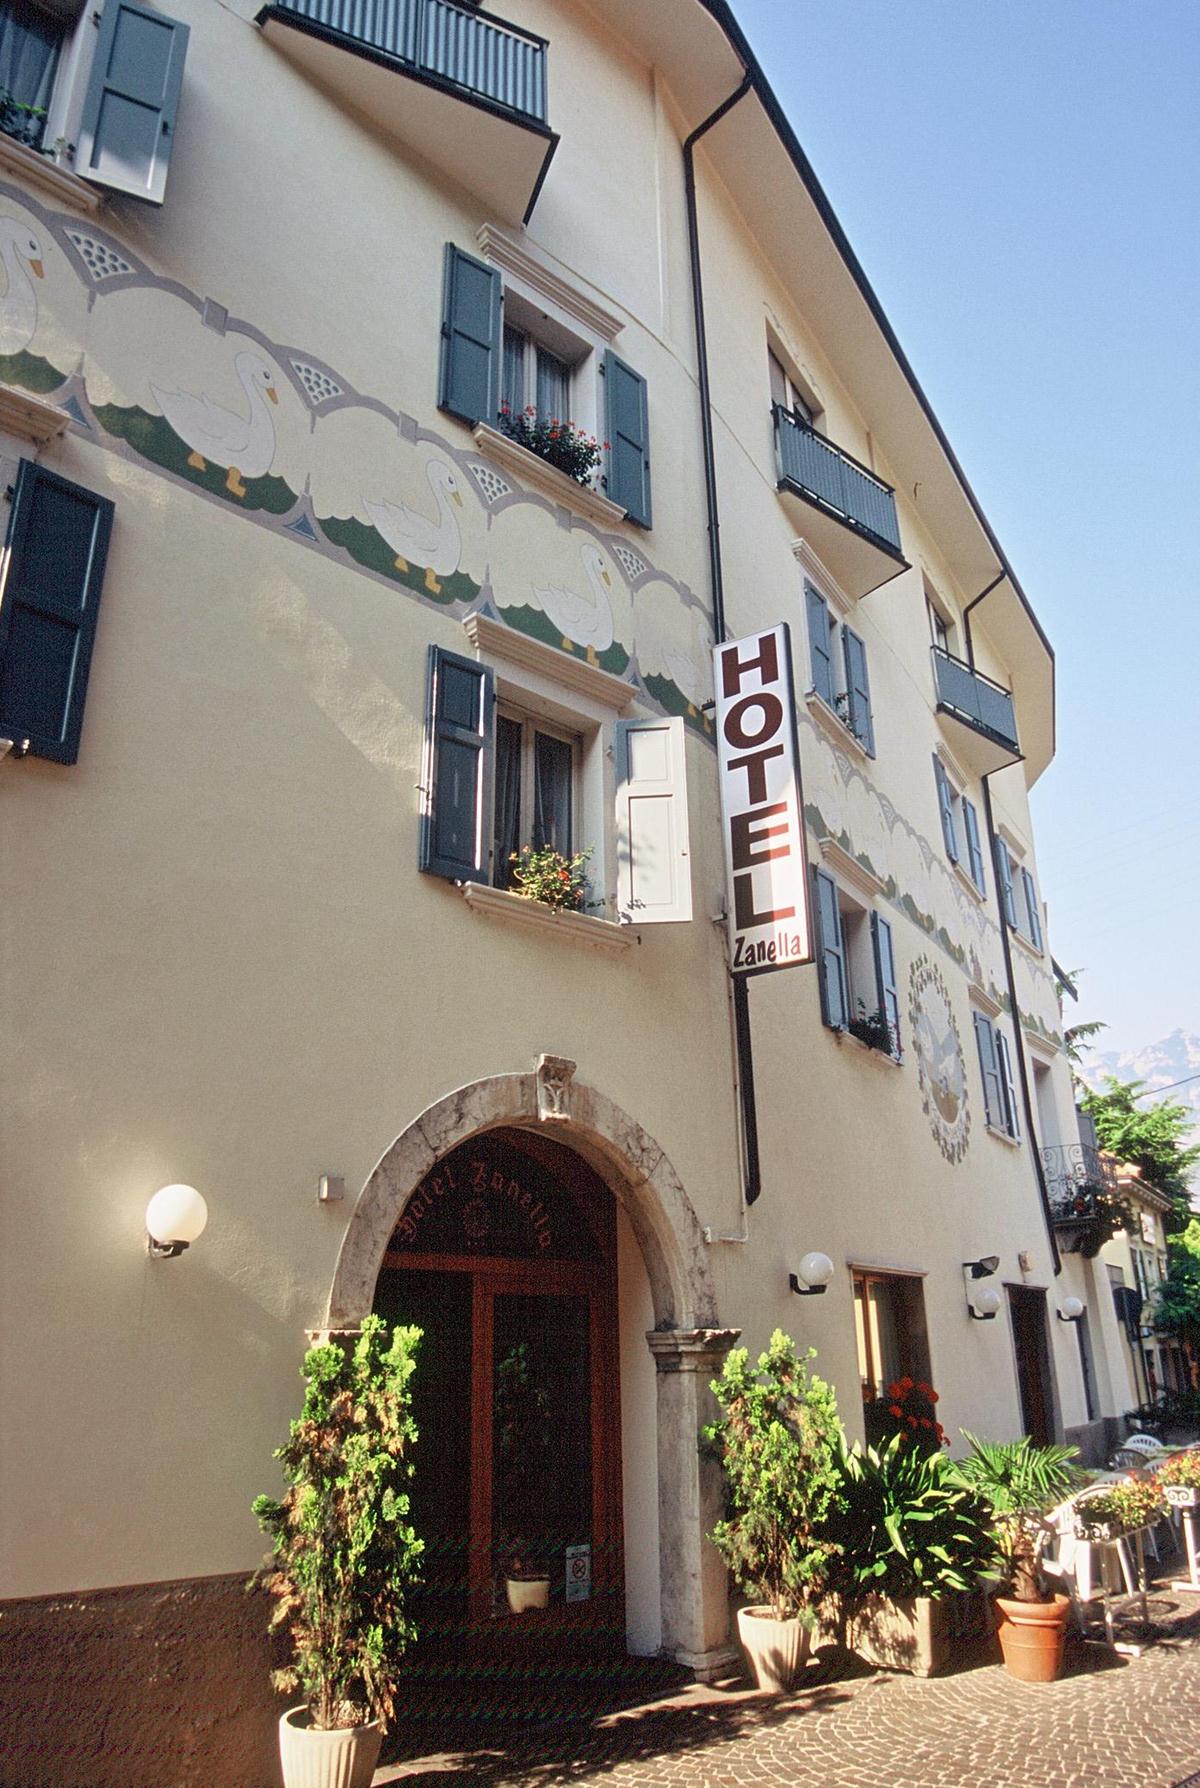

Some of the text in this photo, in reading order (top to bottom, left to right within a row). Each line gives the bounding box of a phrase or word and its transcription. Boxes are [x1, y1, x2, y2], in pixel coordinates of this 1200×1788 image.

[721, 632, 796, 931] HOTEL
[733, 932, 802, 968] Zanella
[398, 1161, 552, 1250] Hotel Zanella
